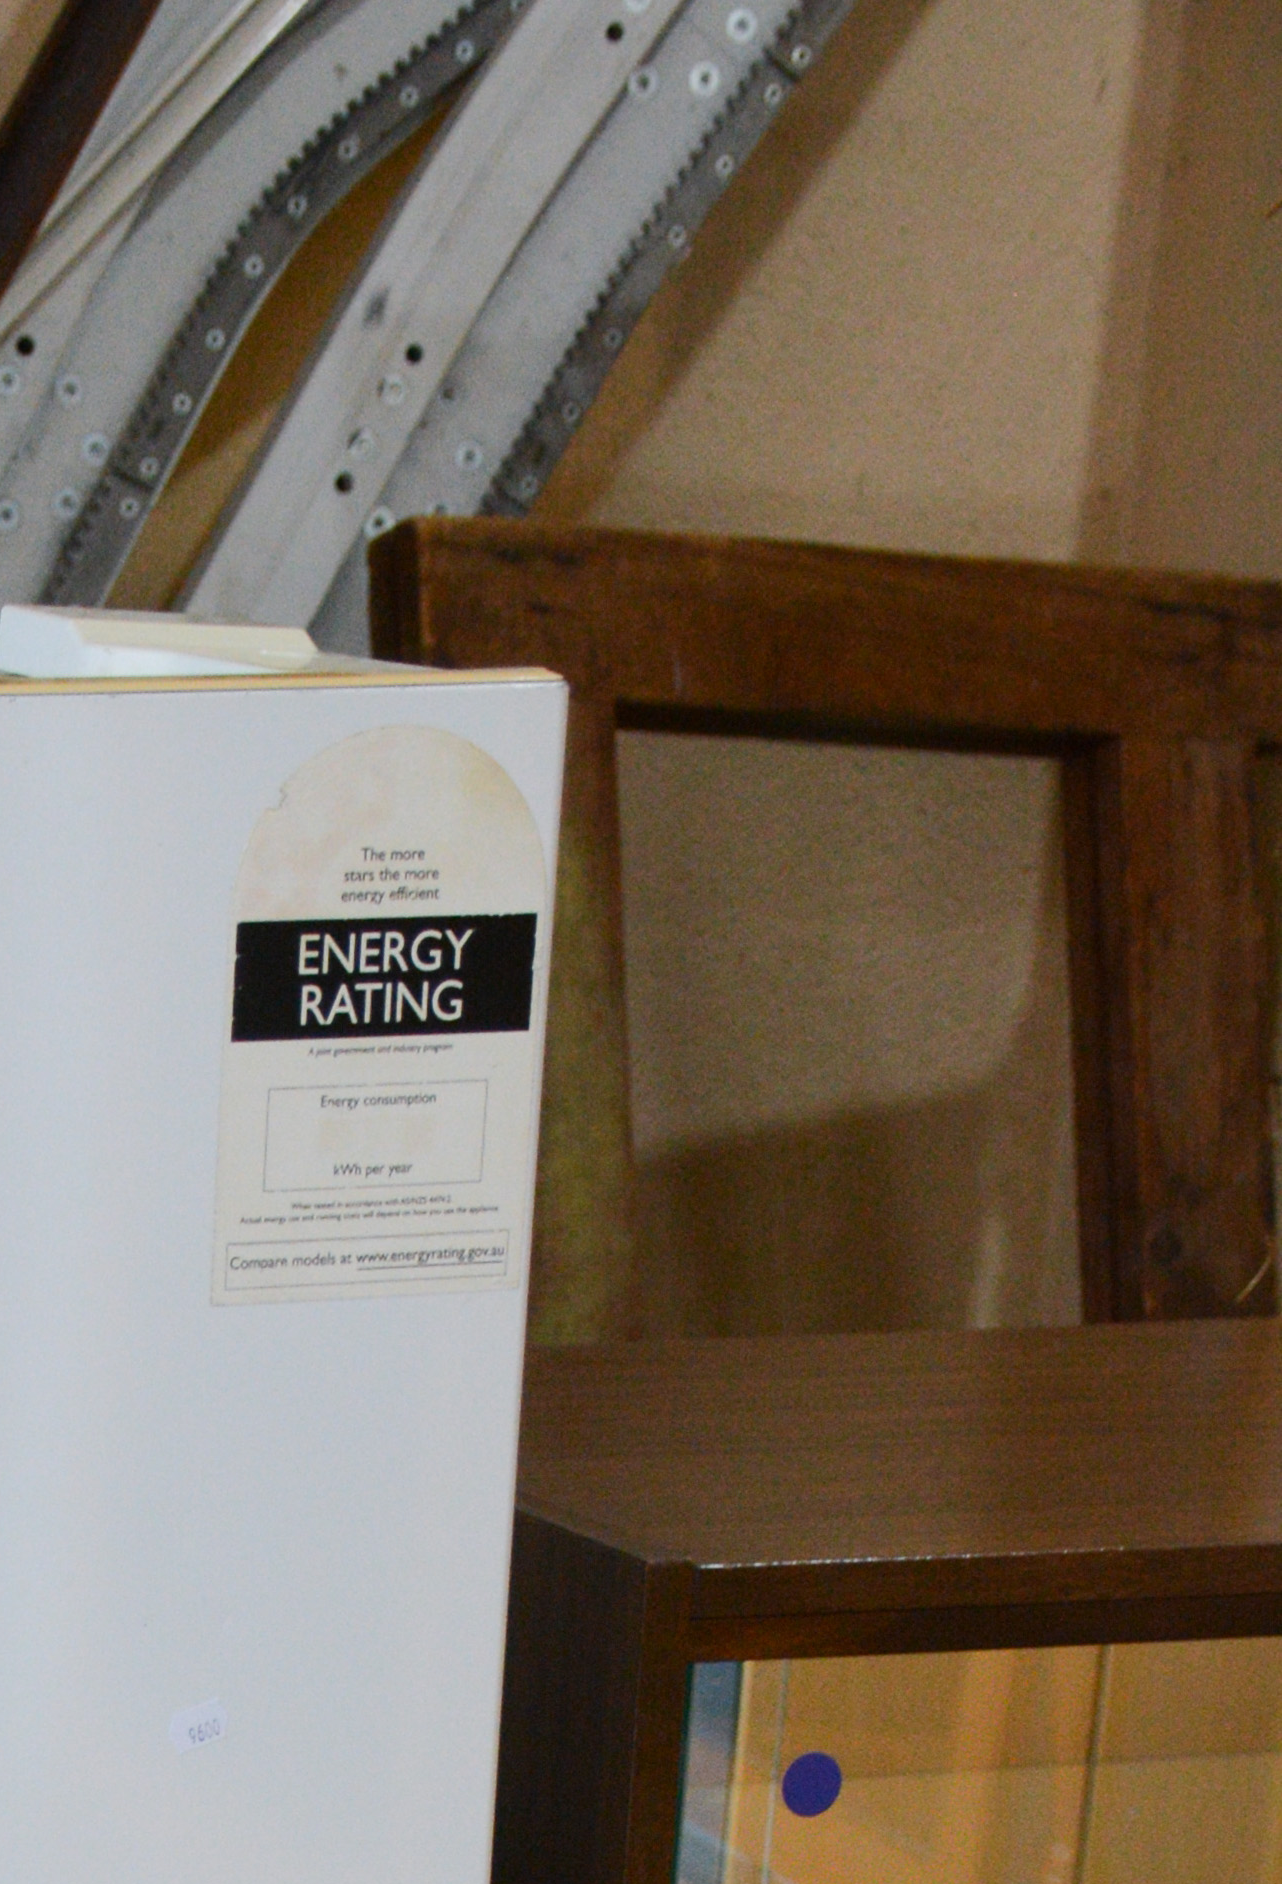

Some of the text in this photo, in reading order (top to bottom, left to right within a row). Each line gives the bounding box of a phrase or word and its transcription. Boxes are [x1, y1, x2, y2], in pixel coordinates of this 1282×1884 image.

[361, 846, 425, 861] The more
[344, 867, 439, 882] stars the more
[341, 886, 440, 905] energy efficient
[298, 929, 475, 976] ENERGY
[299, 979, 464, 1027] RATING
[320, 1092, 437, 1110] Energy consumption
[333, 1162, 413, 1178] kWh per year
[229, 1245, 505, 1273] Compare models at www.energyrating.gov.au
